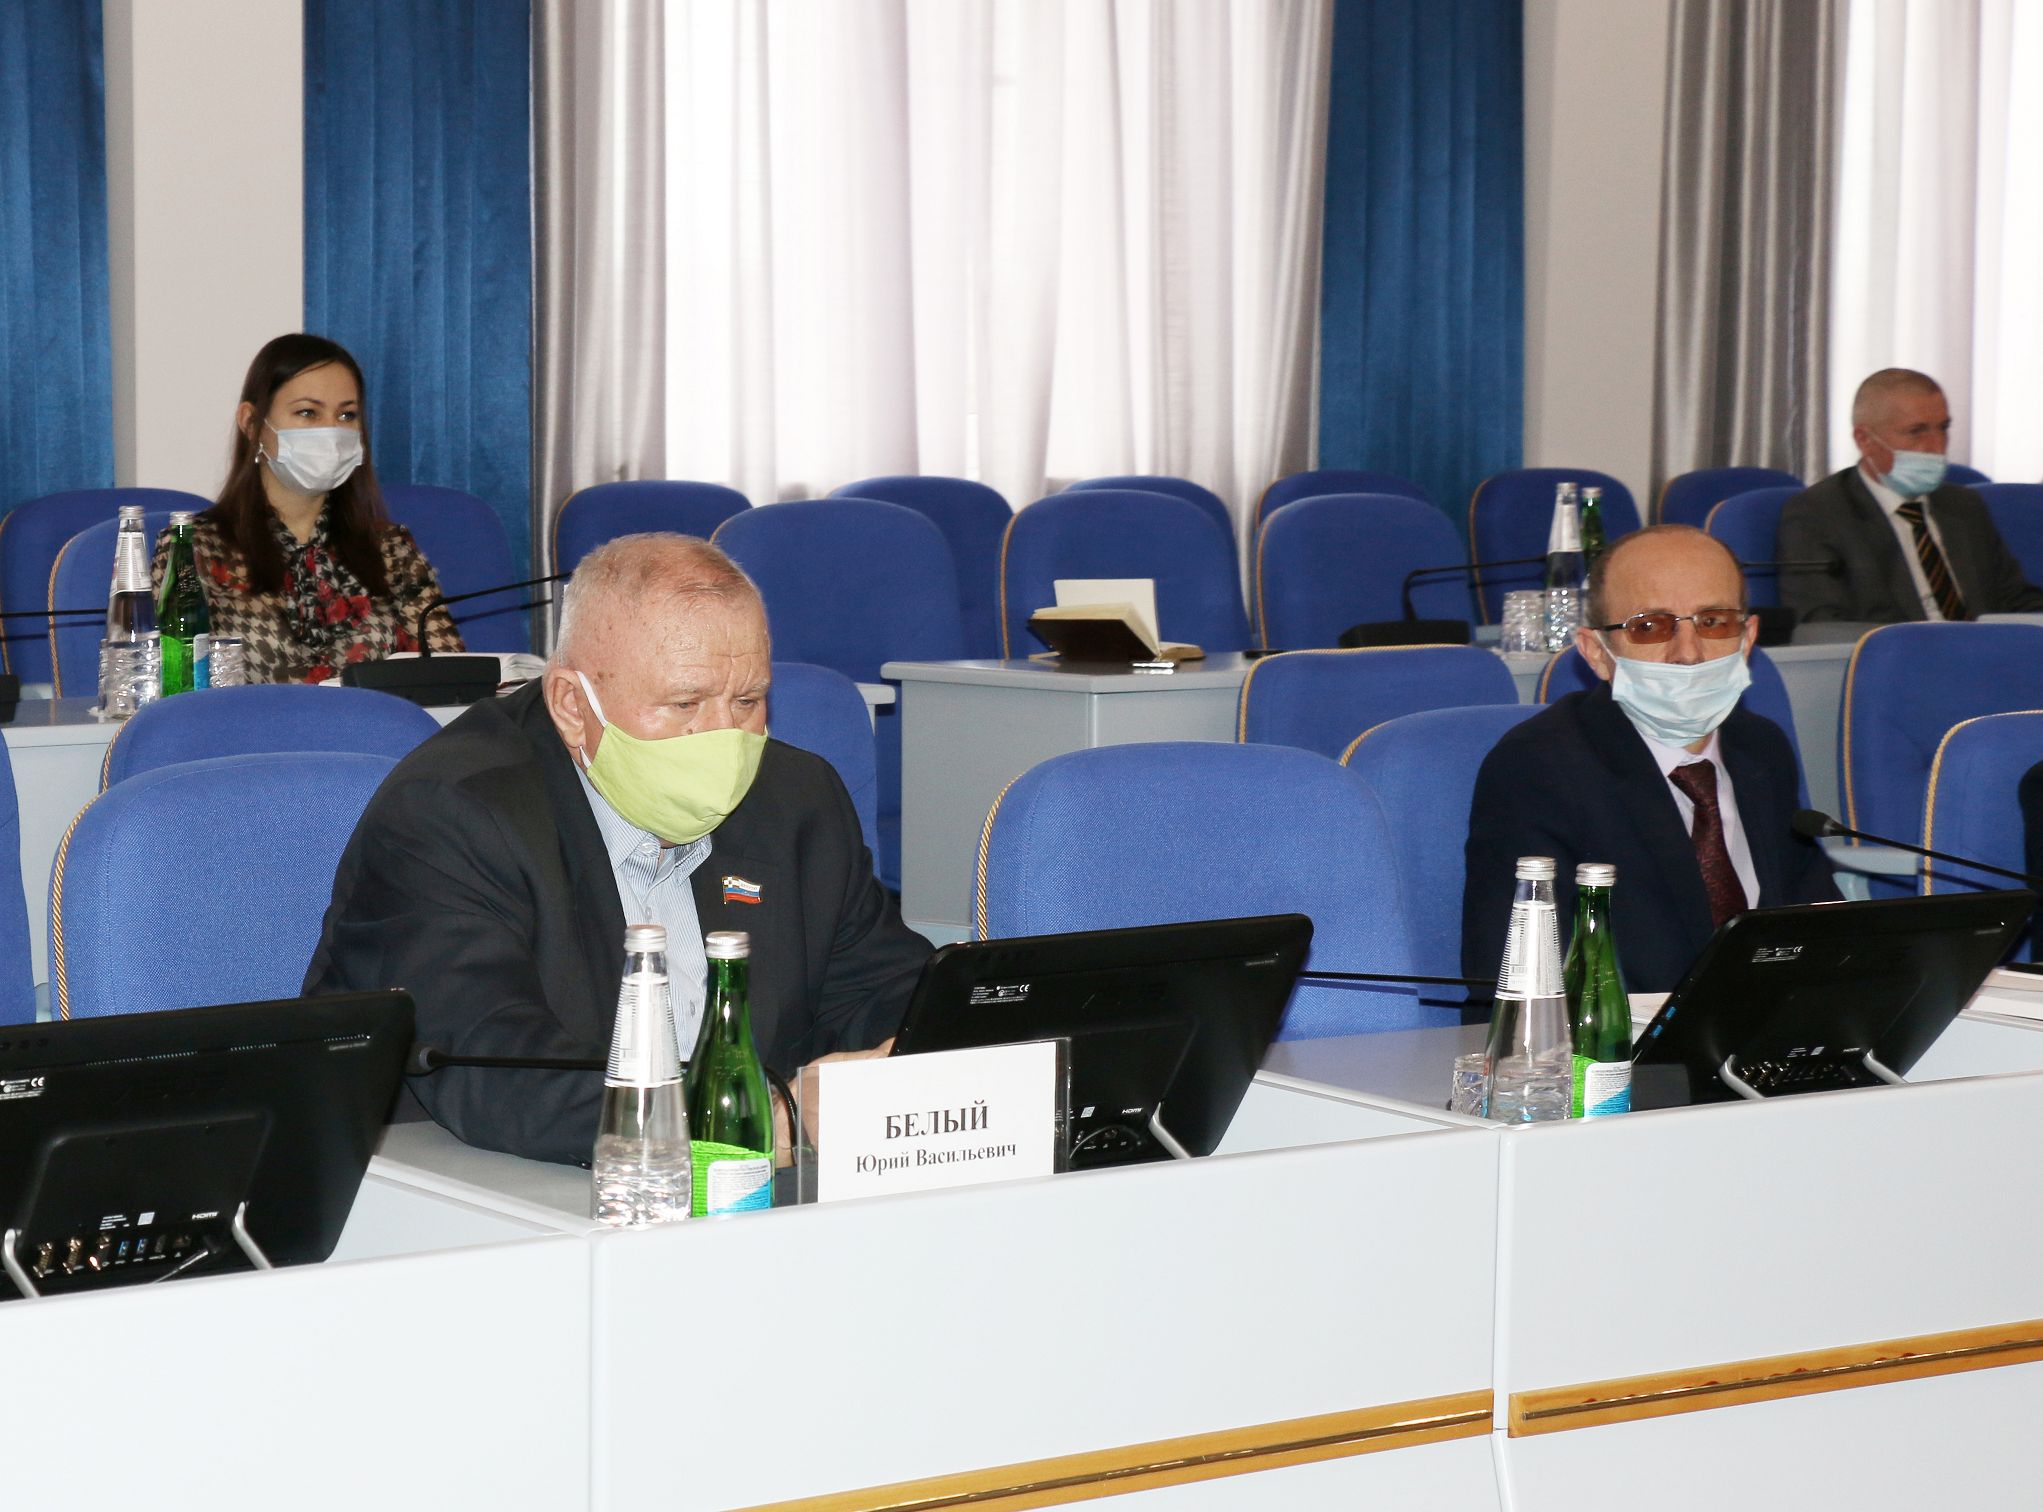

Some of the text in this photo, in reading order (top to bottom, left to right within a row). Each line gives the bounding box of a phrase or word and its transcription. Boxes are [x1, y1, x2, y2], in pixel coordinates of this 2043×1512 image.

[884, 1099, 989, 1140] БЕЛЫЙ
[855, 1143, 1017, 1176] Юрий Васильевич
